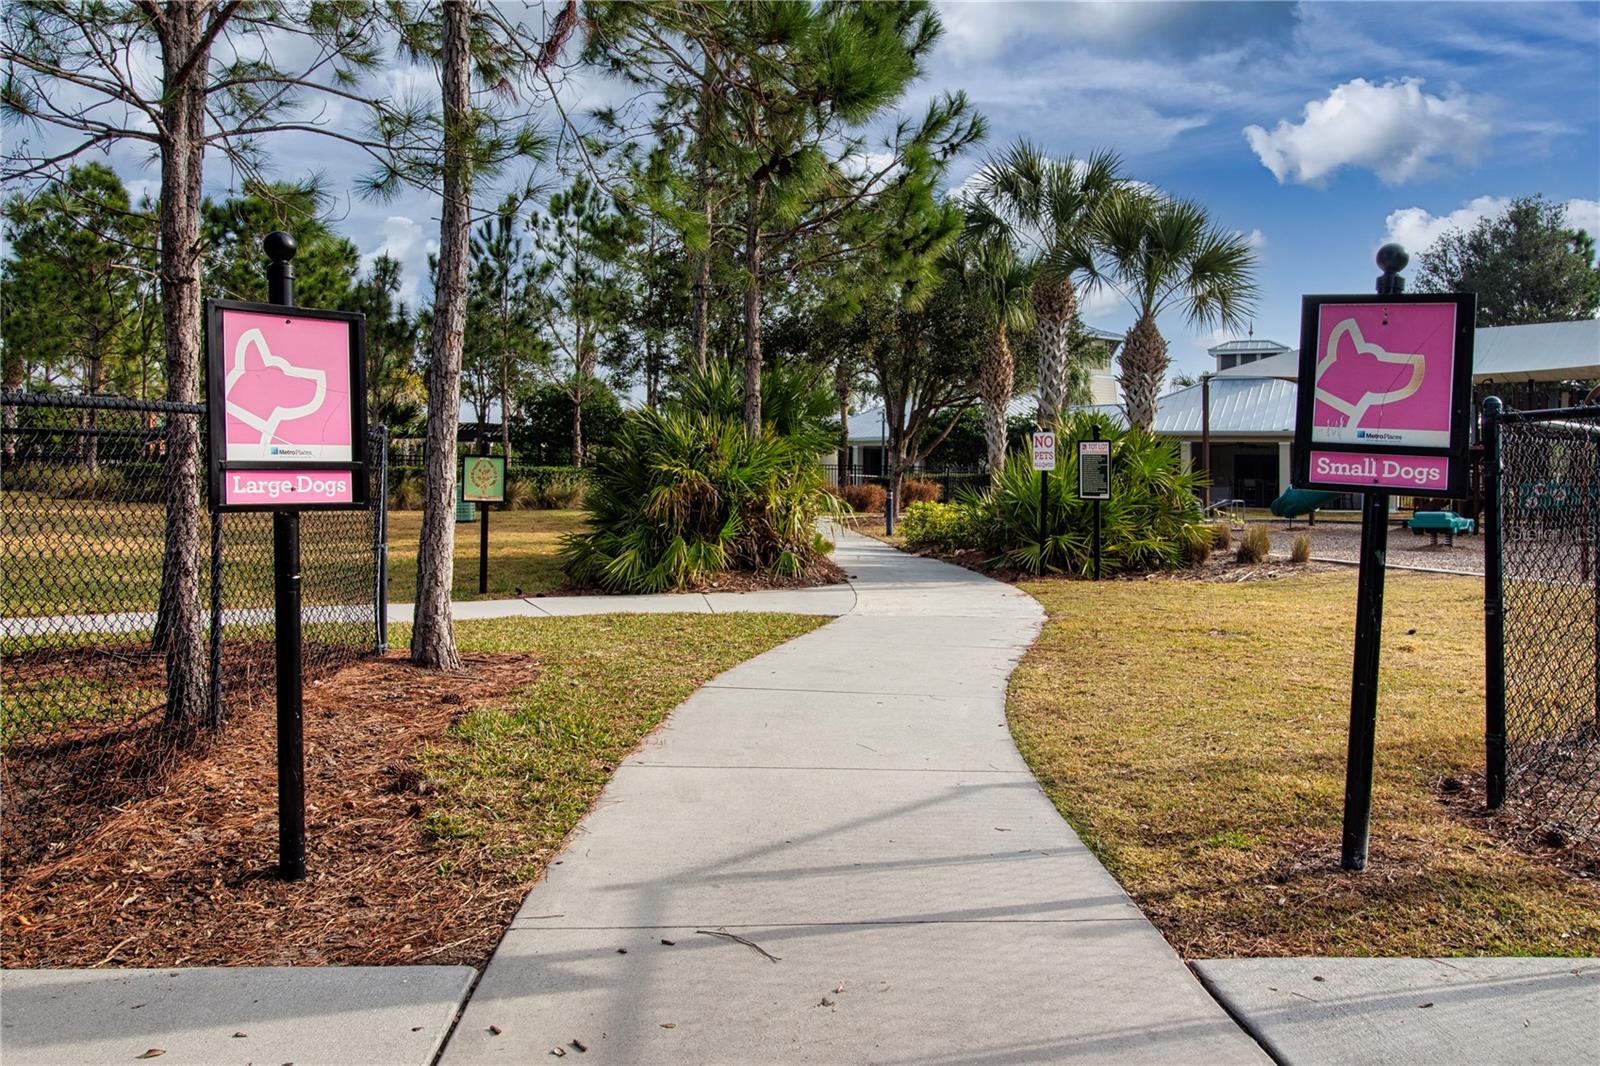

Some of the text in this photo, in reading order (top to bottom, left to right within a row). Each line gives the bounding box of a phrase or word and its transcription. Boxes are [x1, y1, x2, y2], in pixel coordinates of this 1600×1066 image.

[1034, 435, 1053, 448] NO
[1034, 451, 1054, 460] PETS
[1316, 457, 1440, 484] Small Dogs
[233, 475, 346, 498] Large Dogs
